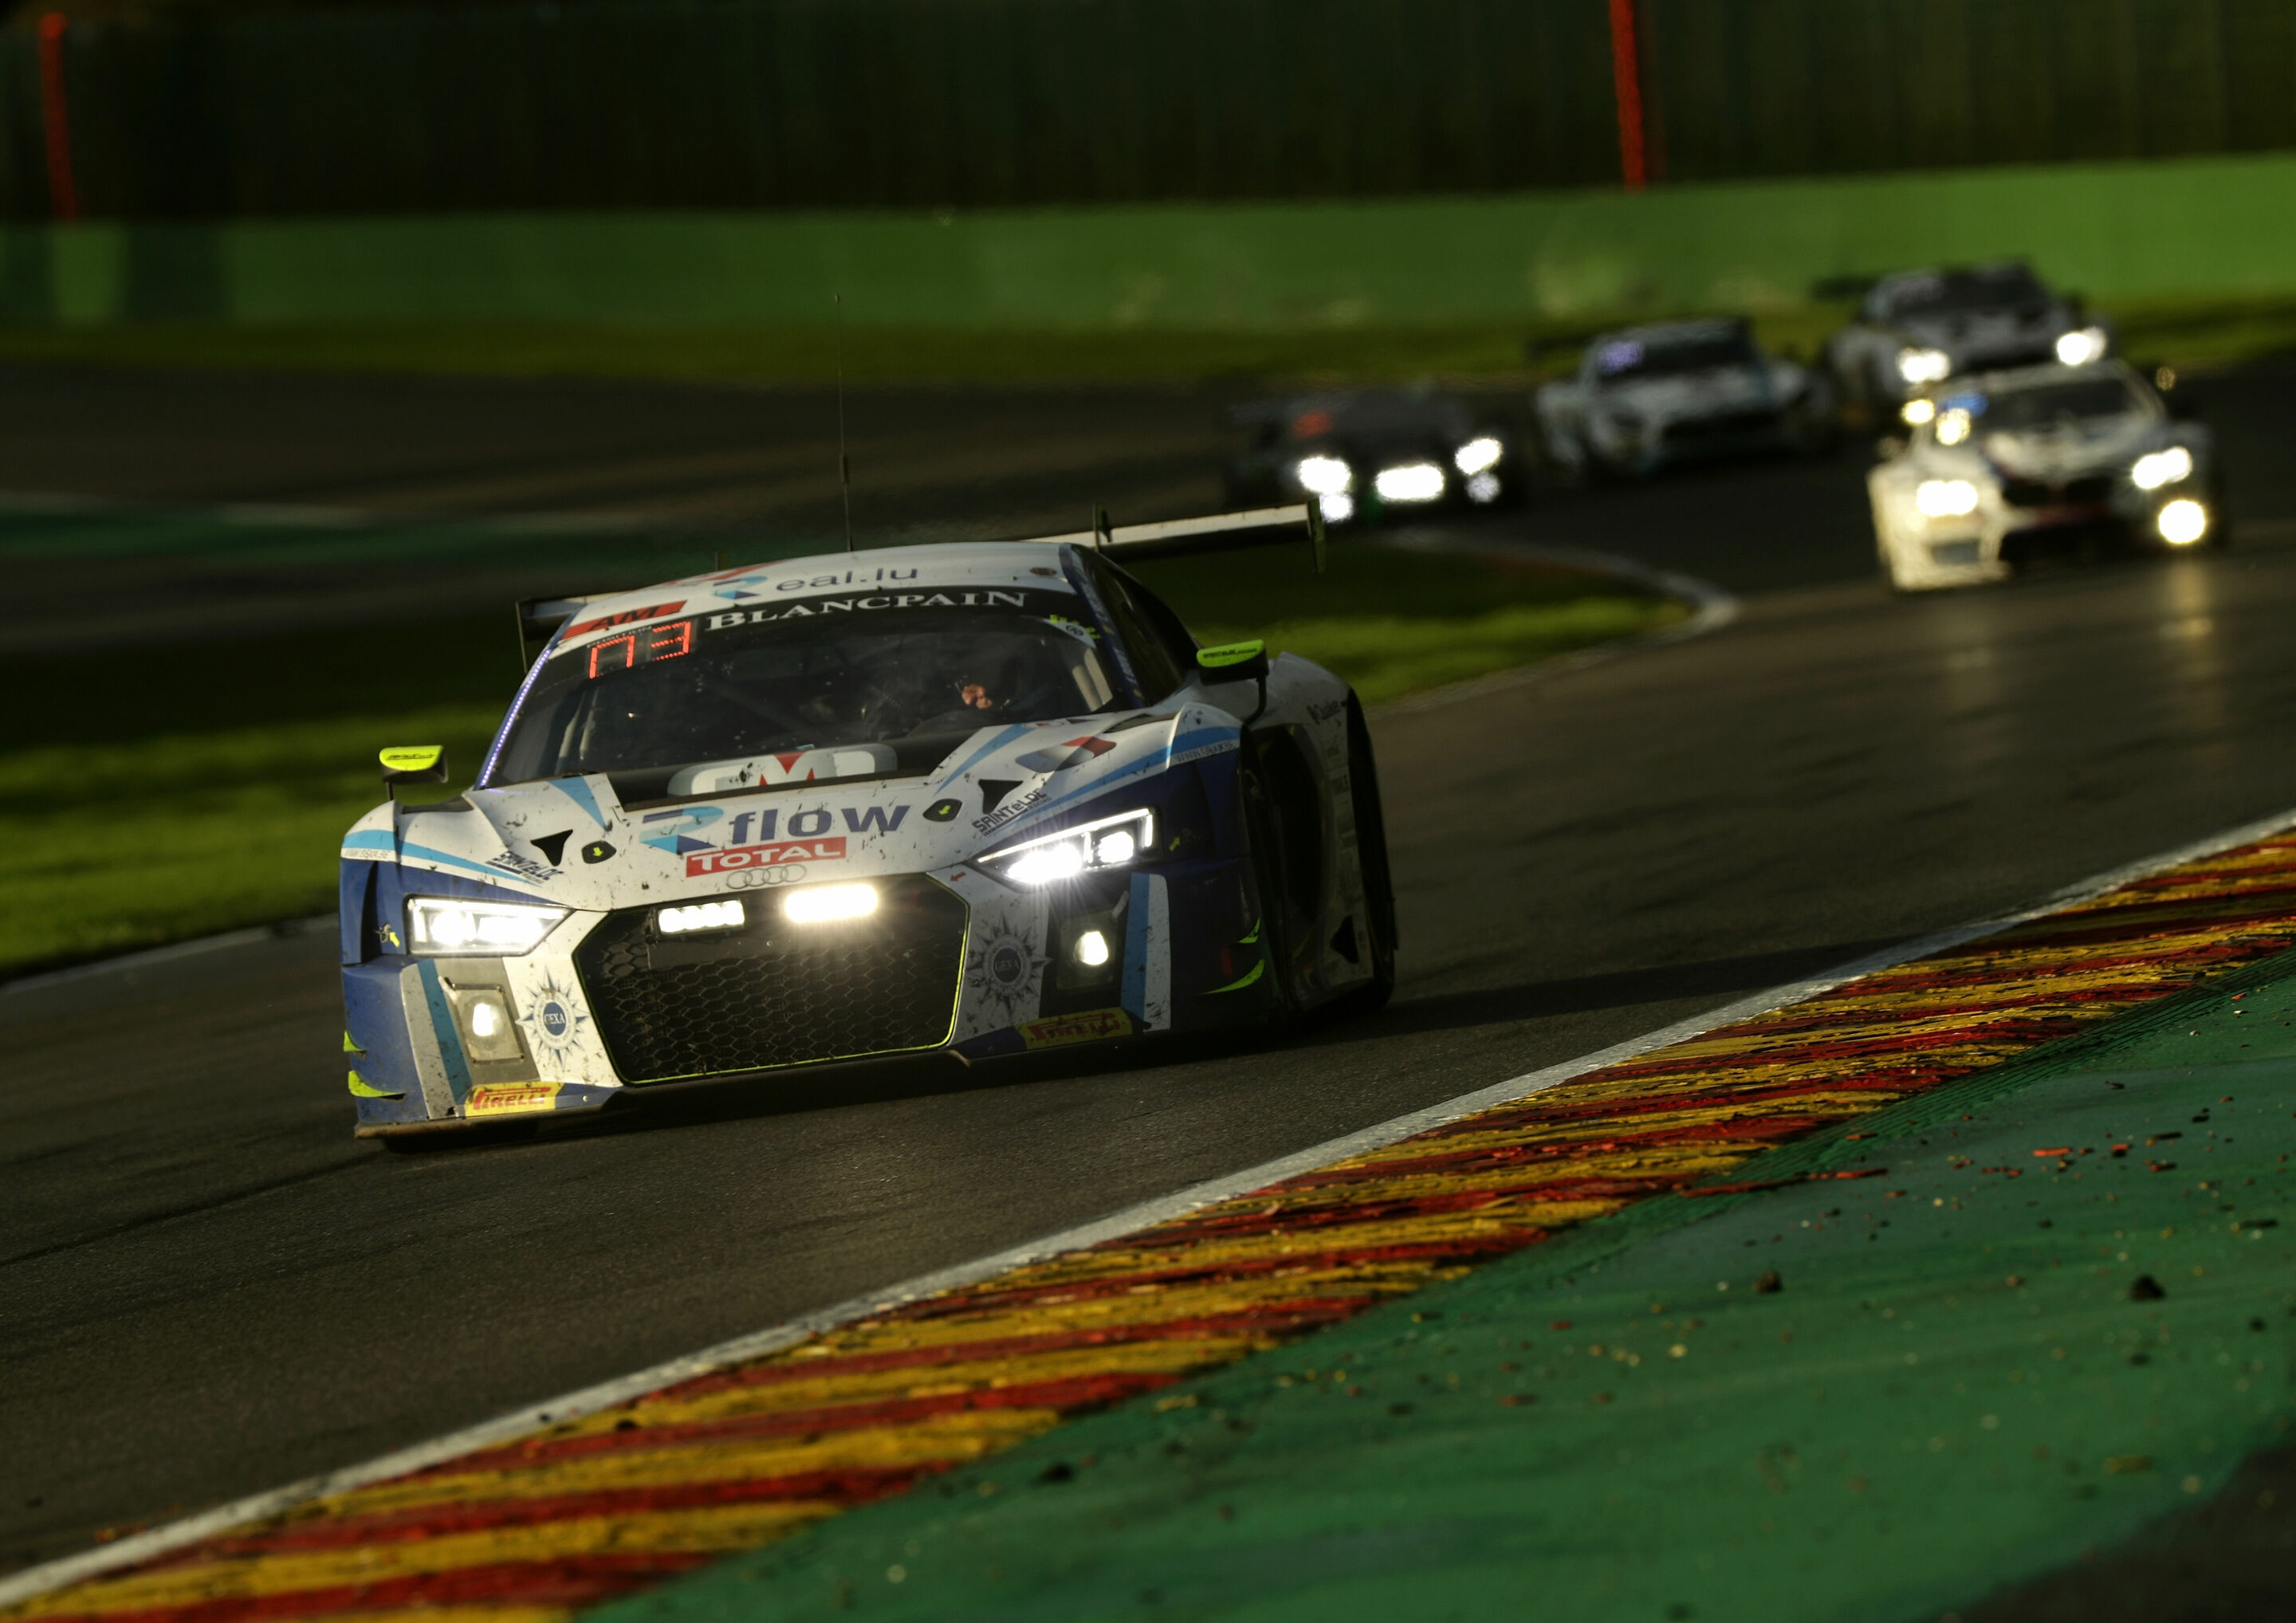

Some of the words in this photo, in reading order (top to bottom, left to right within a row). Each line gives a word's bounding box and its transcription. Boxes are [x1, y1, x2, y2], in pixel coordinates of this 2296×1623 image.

[588, 606, 661, 631] AM
[705, 591, 1029, 632] BLANCPAIN
[690, 843, 843, 870] TOTAL
[473, 1087, 551, 1110] PIRELLI
